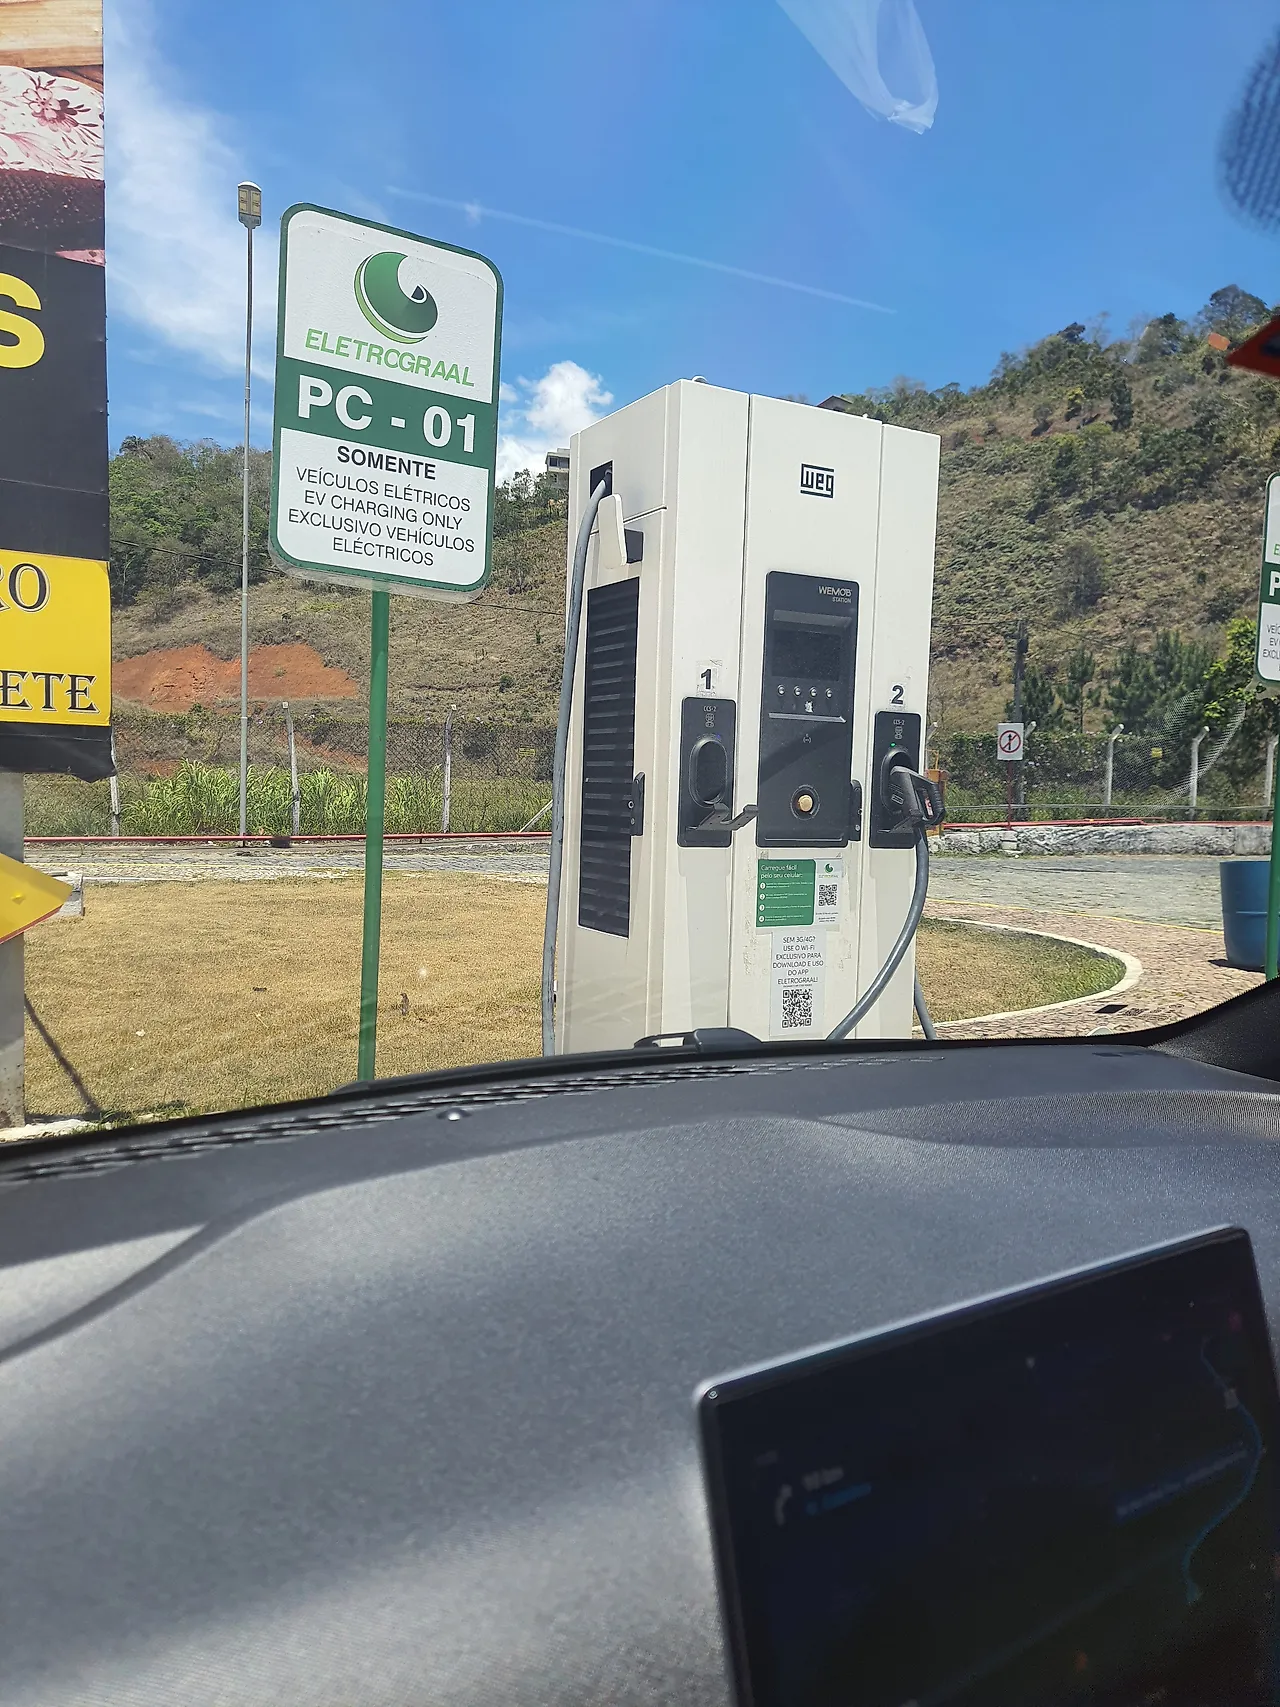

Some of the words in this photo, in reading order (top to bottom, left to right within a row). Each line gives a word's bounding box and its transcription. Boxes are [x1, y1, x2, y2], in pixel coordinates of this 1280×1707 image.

[305, 328, 475, 387] ELETROGRAAL
[298, 374, 373, 431] PC
[423, 405, 476, 453] 01
[336, 445, 436, 480] SOMENTE
[296, 466, 379, 495] VEÍCULOS
[384, 483, 471, 512] ELÉTRICOS
[304, 490, 326, 506] EV
[331, 494, 417, 523] CHARGING
[422, 512, 463, 530] ONLY
[288, 508, 381, 537] EXCLUSIVO
[386, 525, 475, 553] VEHÍCULOS
[333, 537, 434, 566] ELÉCTRICOS
[701, 668, 712, 690] 1
[890, 684, 905, 705] 2
